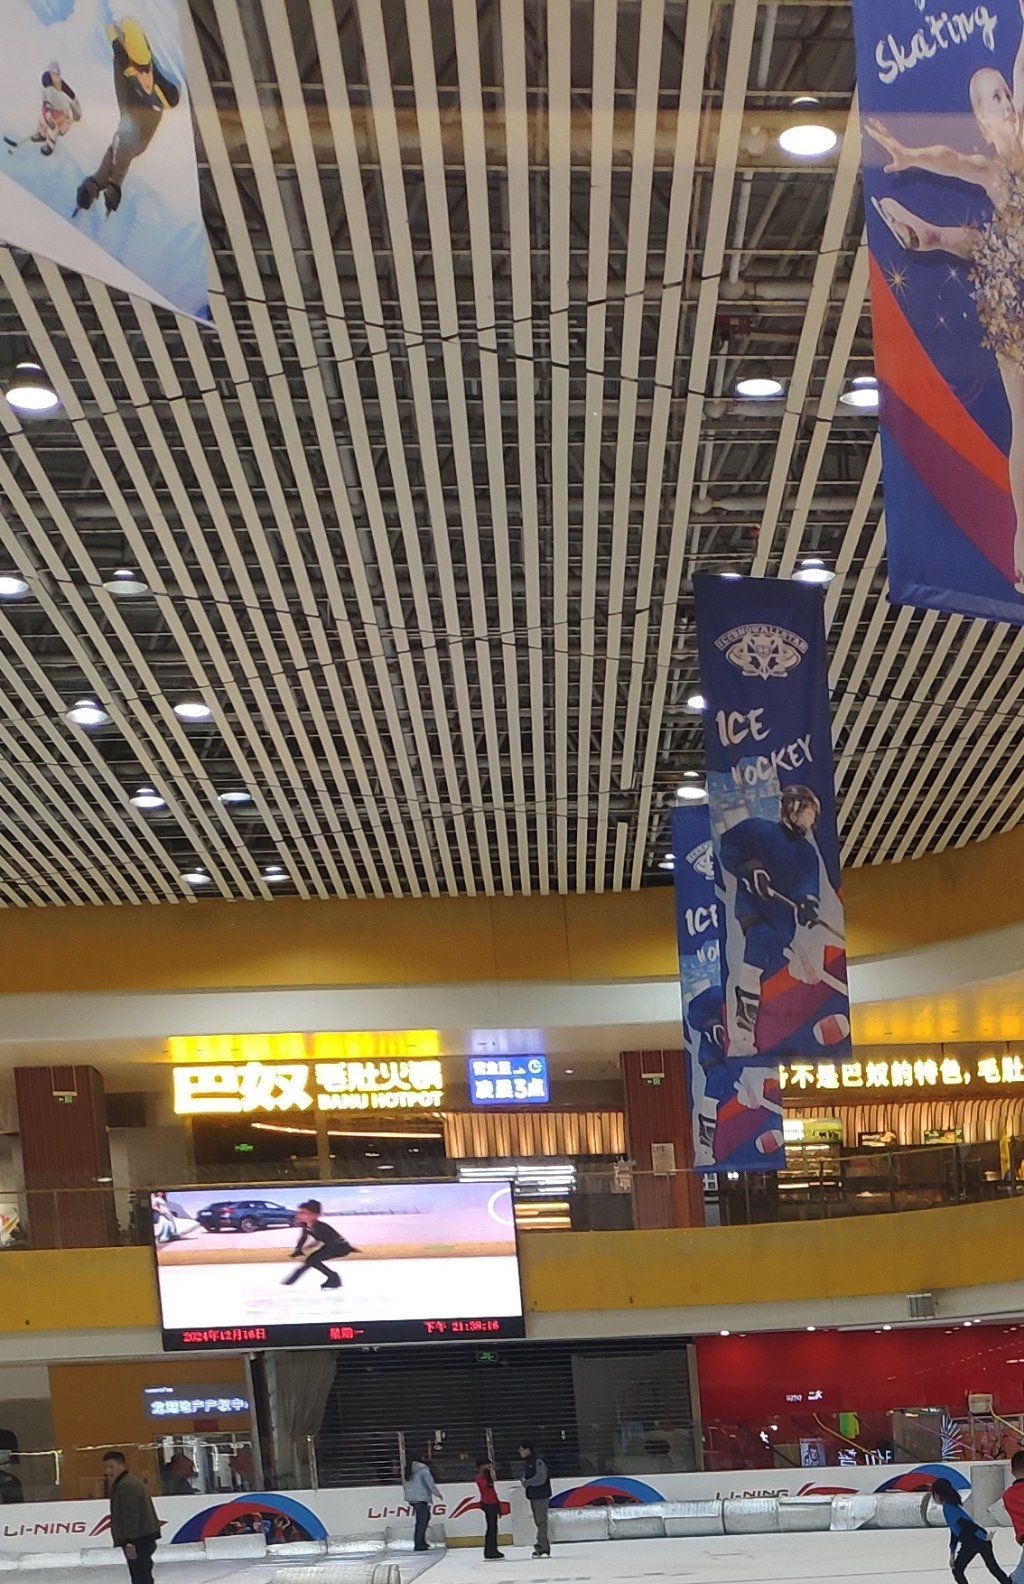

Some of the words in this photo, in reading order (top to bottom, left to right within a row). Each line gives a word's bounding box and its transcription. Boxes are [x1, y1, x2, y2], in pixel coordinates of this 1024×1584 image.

[875, 6, 998, 84] Skating
[715, 707, 771, 747] ICE
[731, 733, 813, 786] HOCKEY
[4, 1521, 87, 1537] LI-NING
